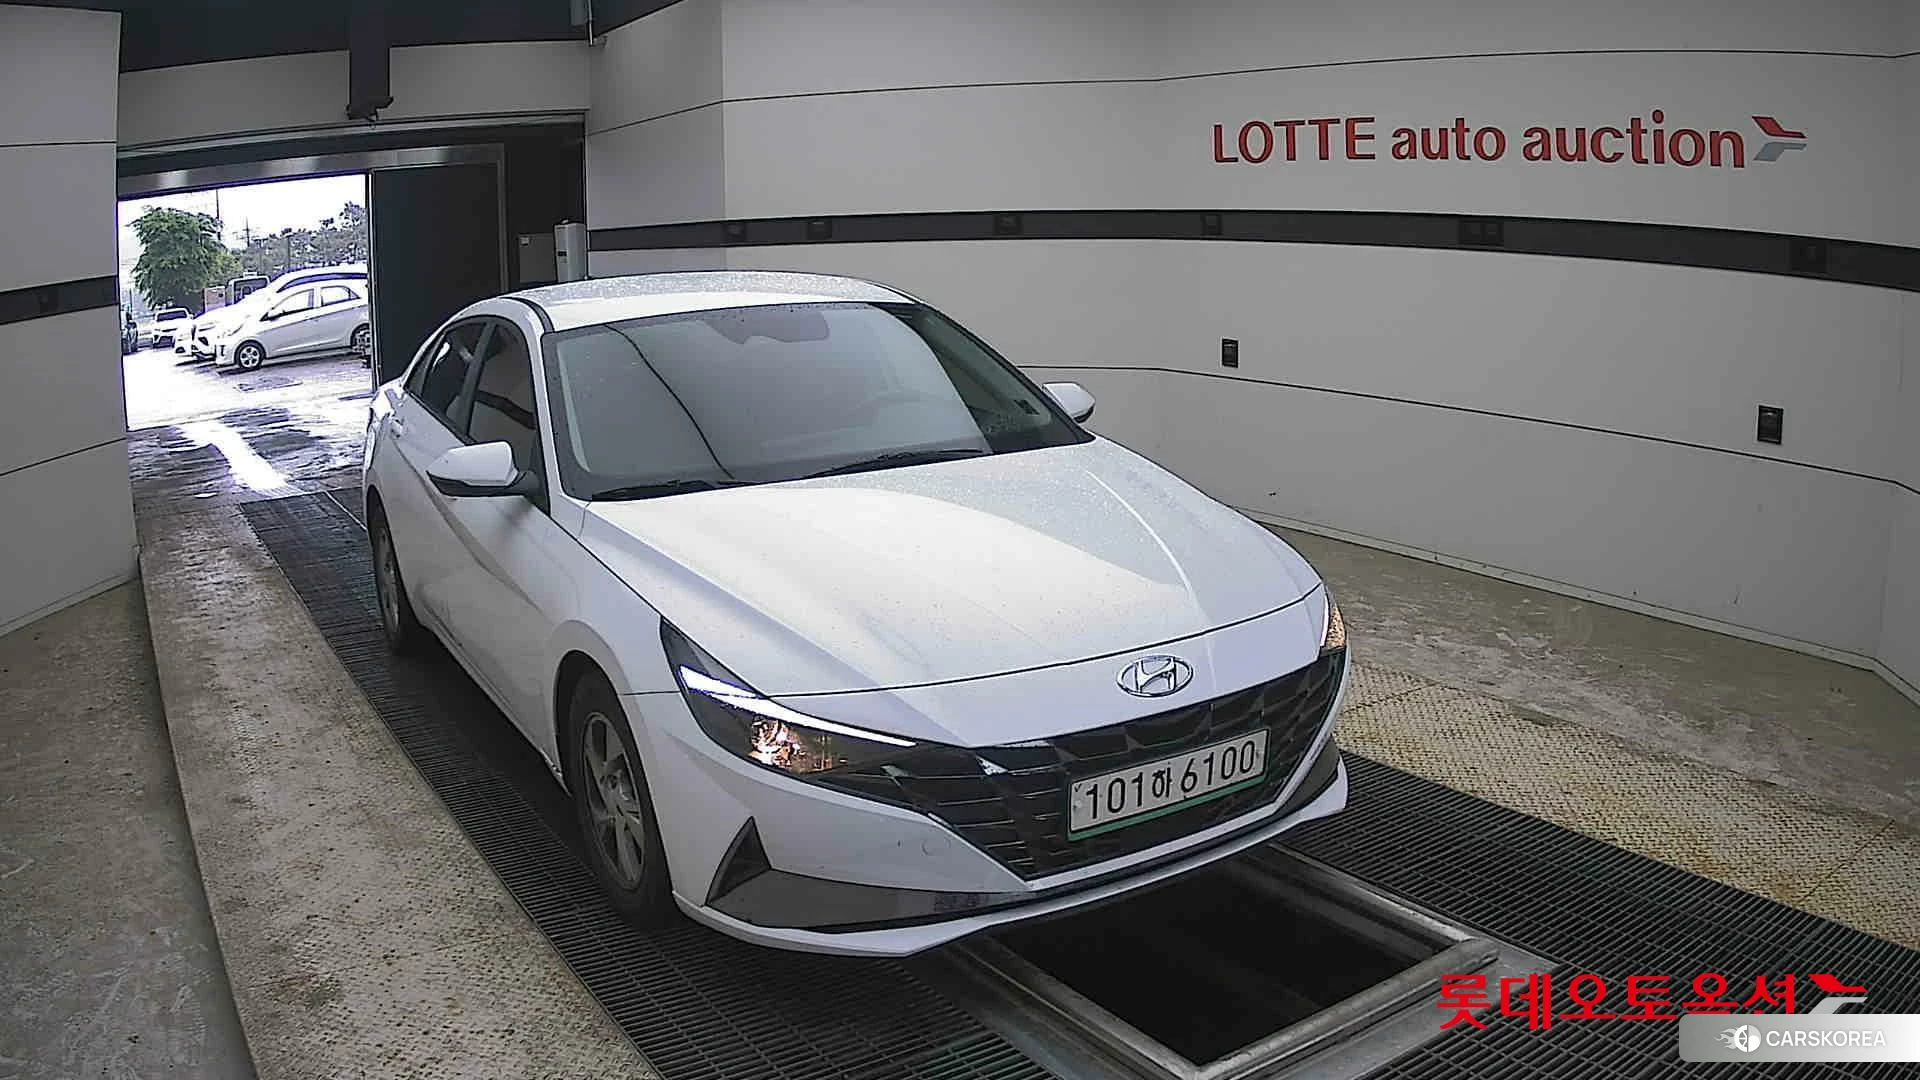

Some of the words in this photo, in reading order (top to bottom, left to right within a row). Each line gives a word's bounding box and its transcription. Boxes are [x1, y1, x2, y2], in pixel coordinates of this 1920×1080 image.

[1213, 117, 1376, 163] LOTTE
[1391, 117, 1506, 161] auto
[1522, 109, 1745, 168] auction
